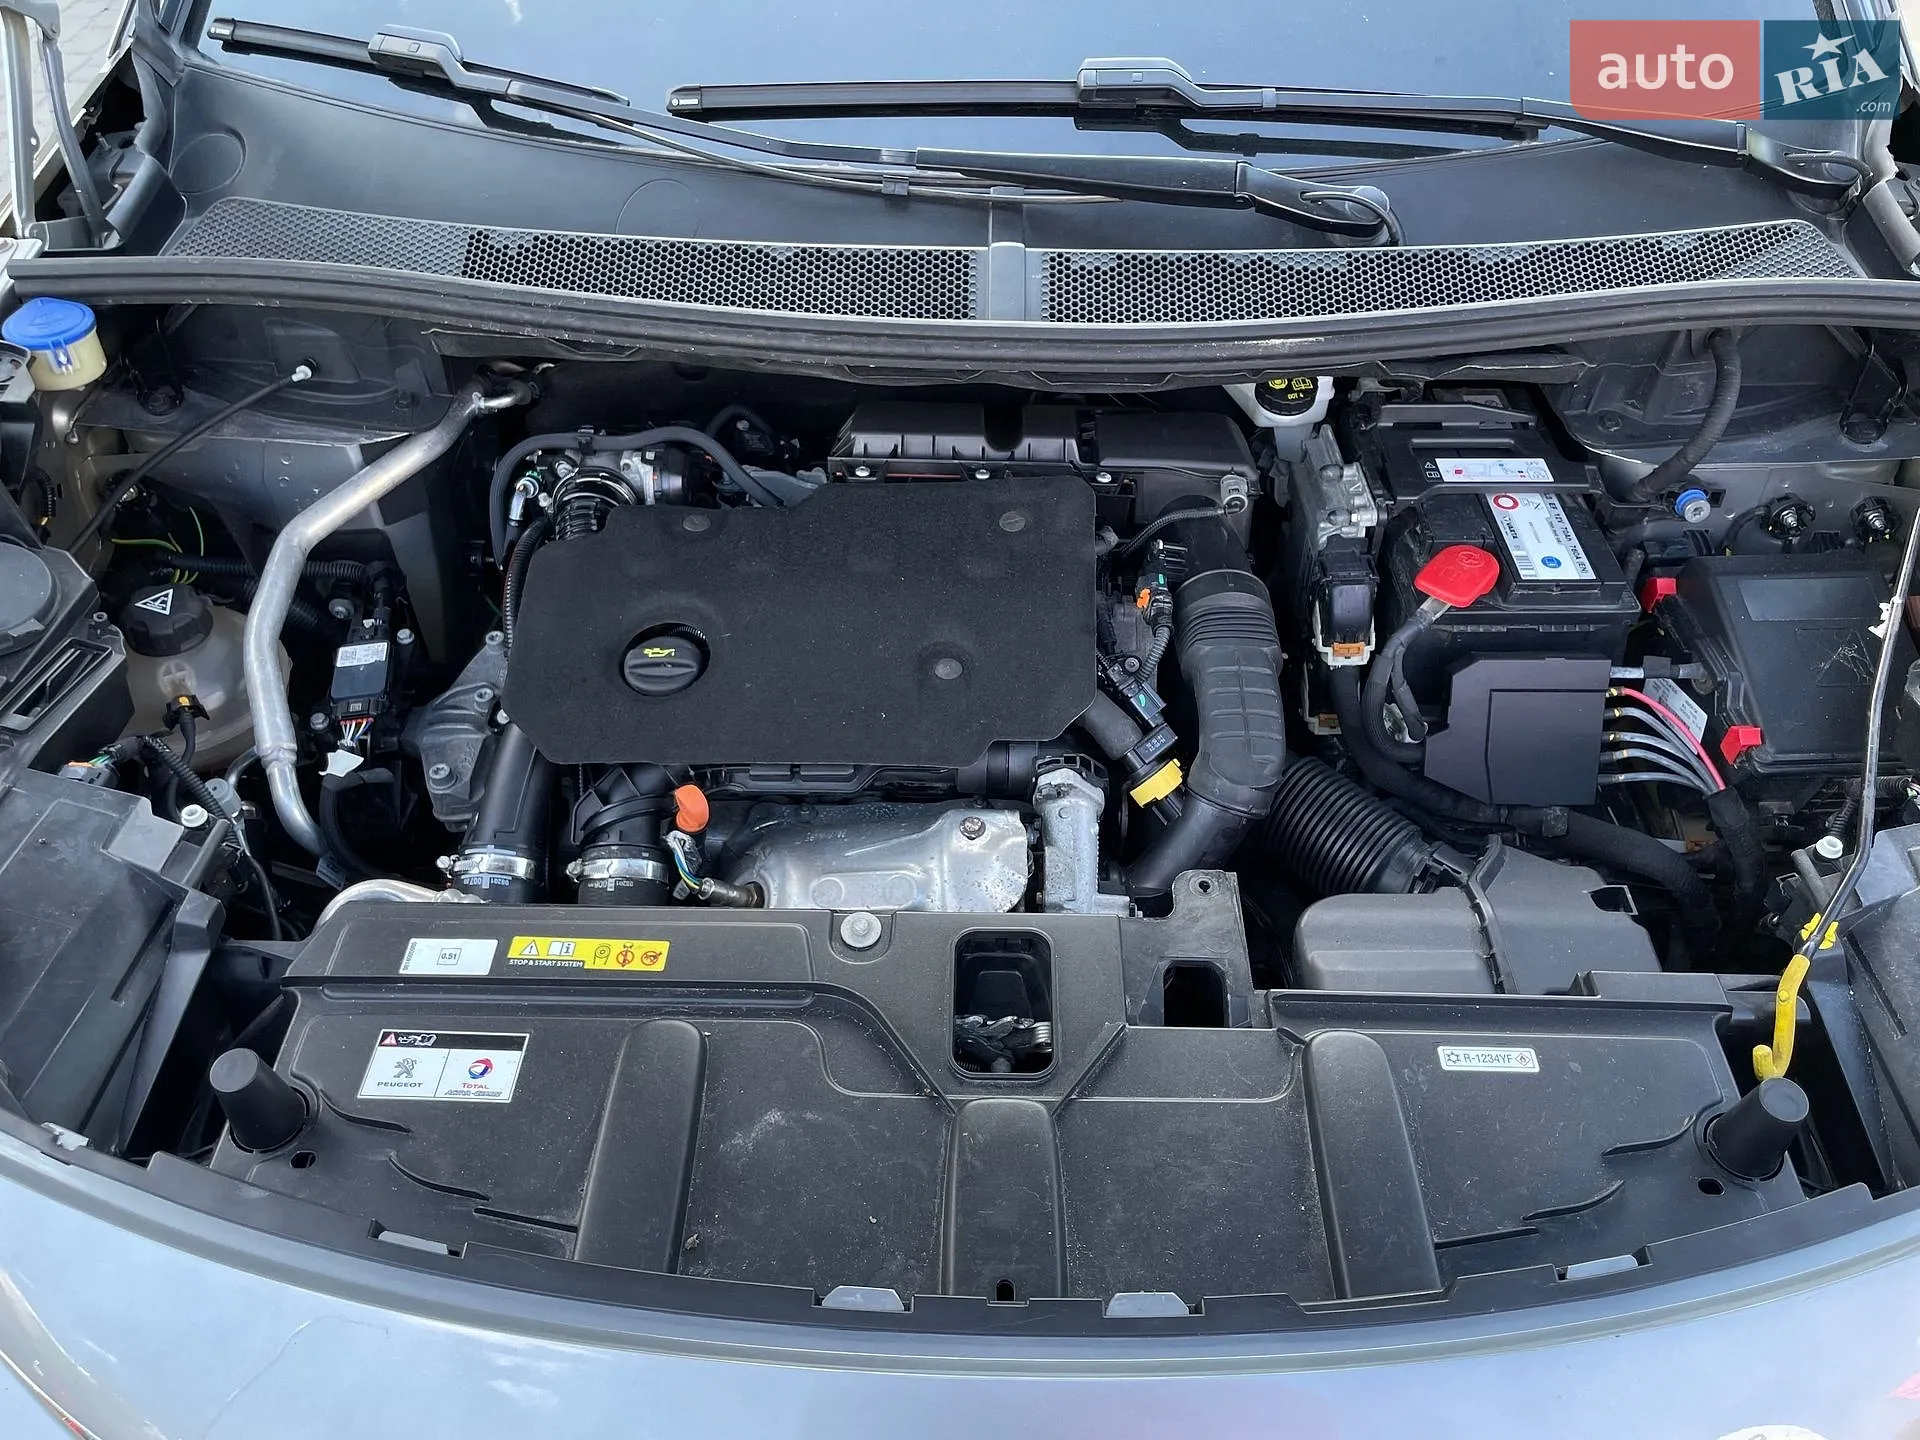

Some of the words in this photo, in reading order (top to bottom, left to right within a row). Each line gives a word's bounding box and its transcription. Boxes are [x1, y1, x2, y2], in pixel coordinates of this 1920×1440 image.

[557, 960, 584, 968] SYSTEM
[1463, 1053, 1513, 1064] R-1234YF
[462, 1082, 489, 1090] TOTAL
